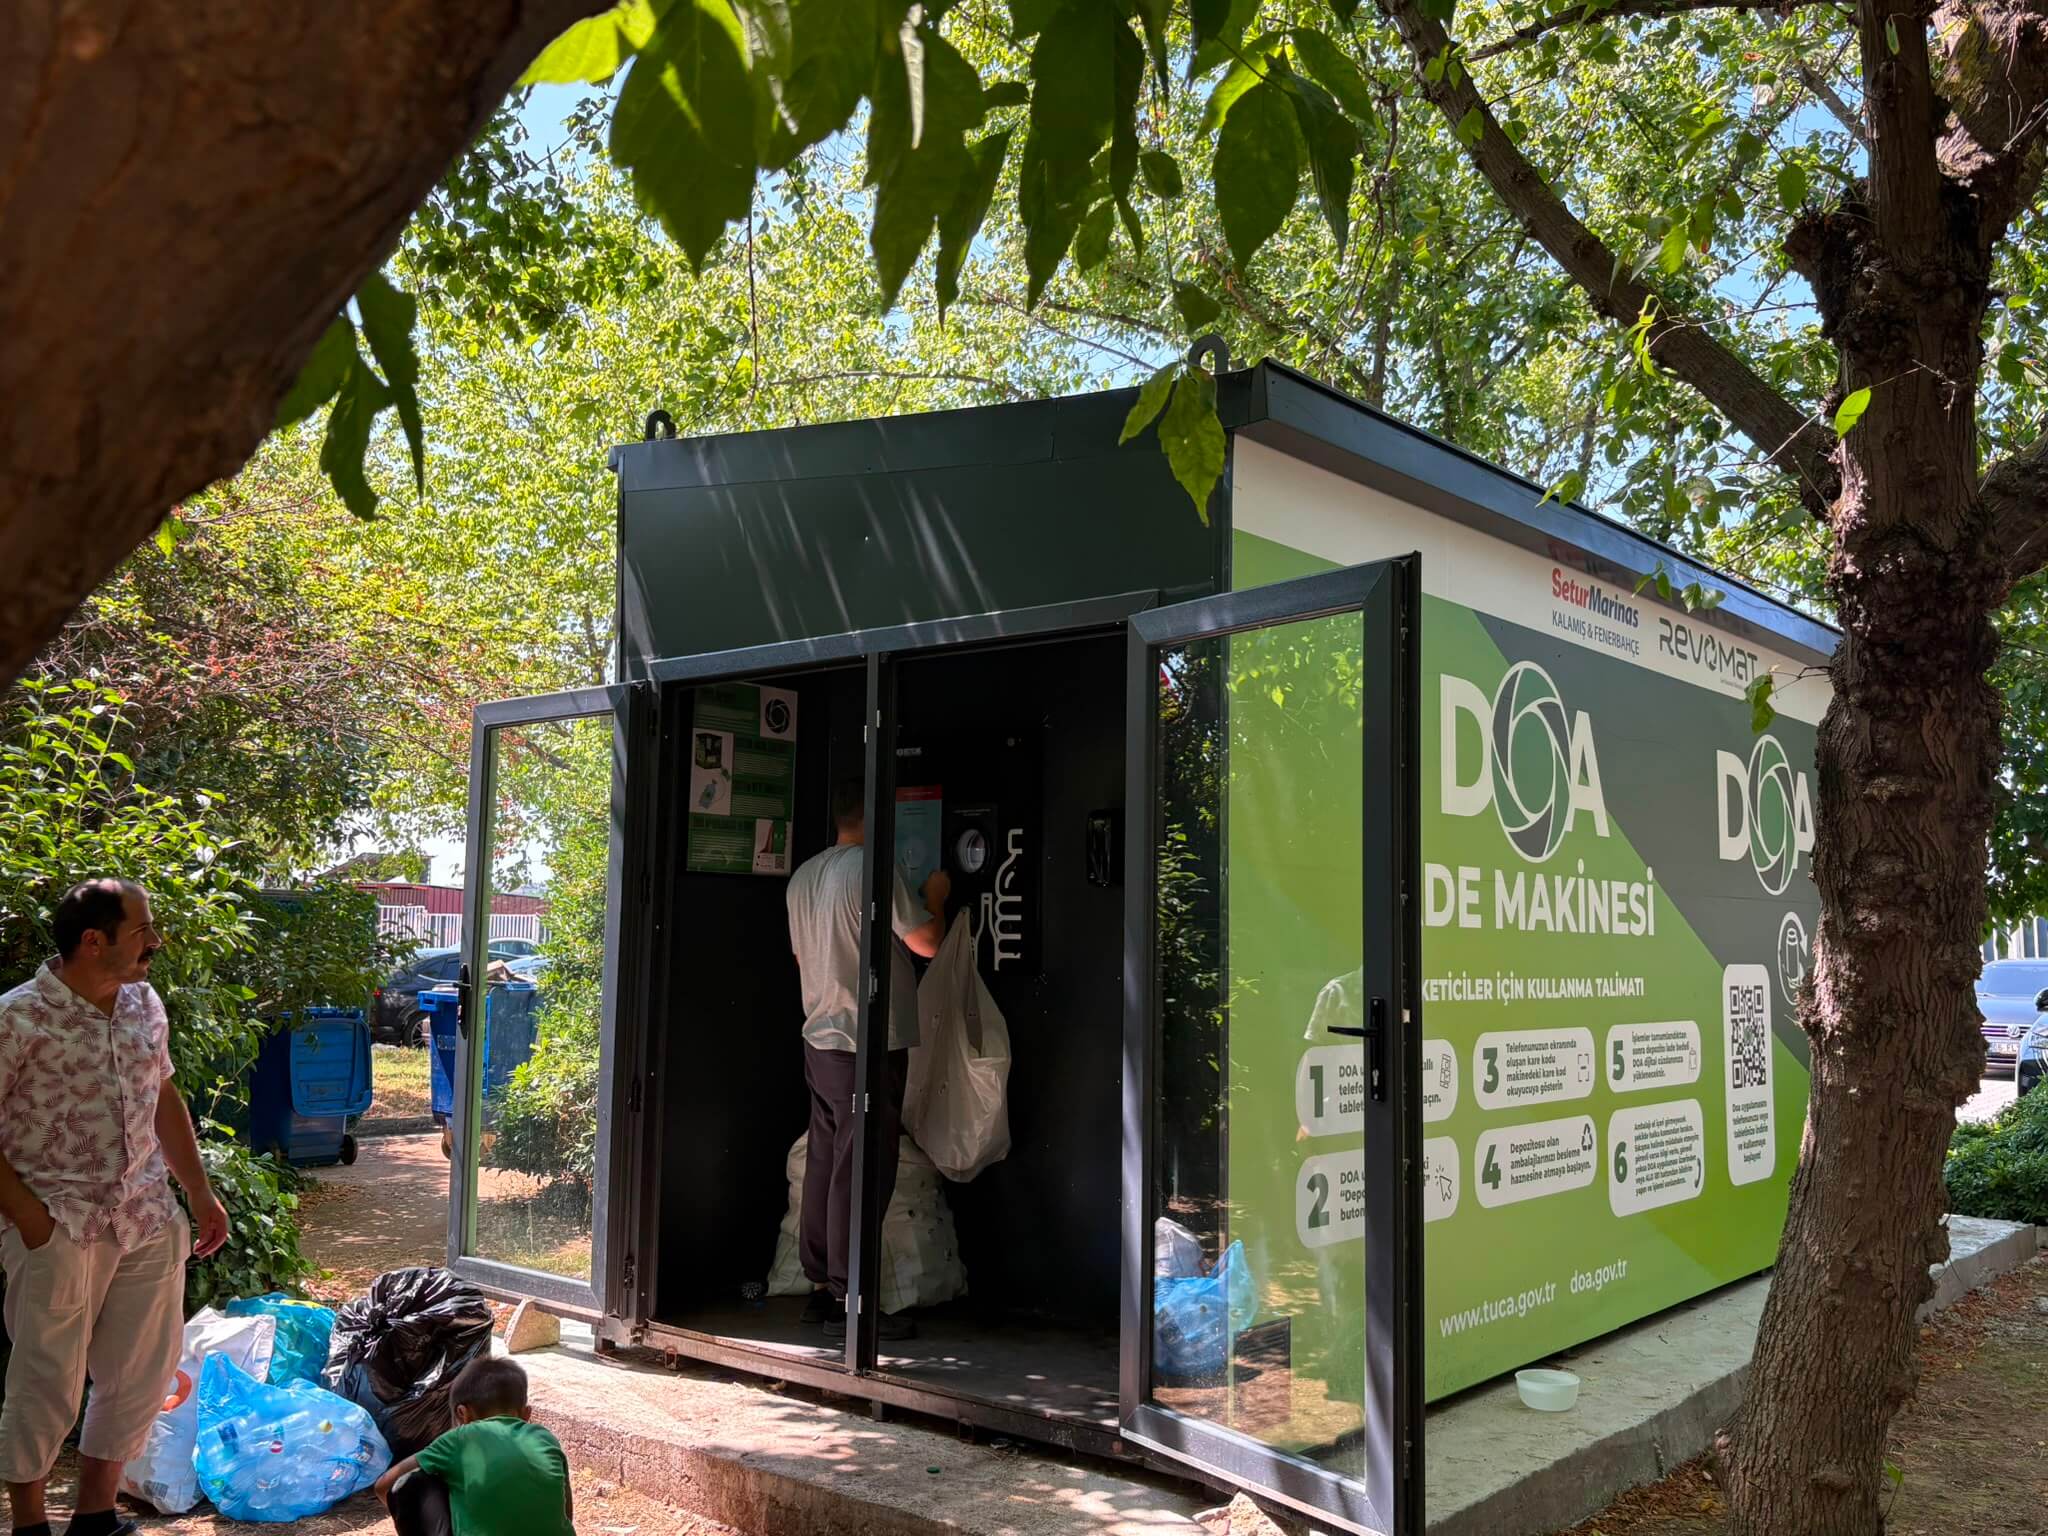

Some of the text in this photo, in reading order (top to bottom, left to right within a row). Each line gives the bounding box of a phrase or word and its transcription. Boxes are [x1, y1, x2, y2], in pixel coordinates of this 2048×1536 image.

[1552, 567, 1639, 628] SeturMarinas
[1587, 627, 1594, 640] &
[1594, 626, 1640, 657] FENERBAHÇE
[1440, 660, 1610, 863] DOA
[1422, 859, 1655, 936] DE MAKİNESİ
[1497, 970, 1524, 1006] İÇİN
[1527, 977, 1594, 999] KULLANMA
[1595, 971, 1645, 997] TALİMATI
[1506, 1039, 1577, 1053] Telefonunuzun ekranında
[1506, 1054, 1556, 1069] oluşan kare kodu
[1612, 1040, 1625, 1081] 5
[1339, 1064, 1358, 1078] DOA
[1482, 1047, 1499, 1094] 3
[1506, 1066, 1566, 1082] makinedeki kare kod
[1310, 1065, 1324, 1118] 1
[1506, 1085, 1539, 1097] okuyucuya
[1510, 1136, 1559, 1154] Depozitosu olan
[1614, 1141, 1628, 1184] 6
[1340, 1170, 1359, 1185] DOA
[1481, 1144, 1501, 1190] 4
[1510, 1169, 1542, 1185] haznesine
[1544, 1165, 1565, 1178] atmaya
[1306, 1172, 1330, 1229] 2
[1440, 1258, 1627, 1338] www.tuca.gov.tr doa.gov.tr
